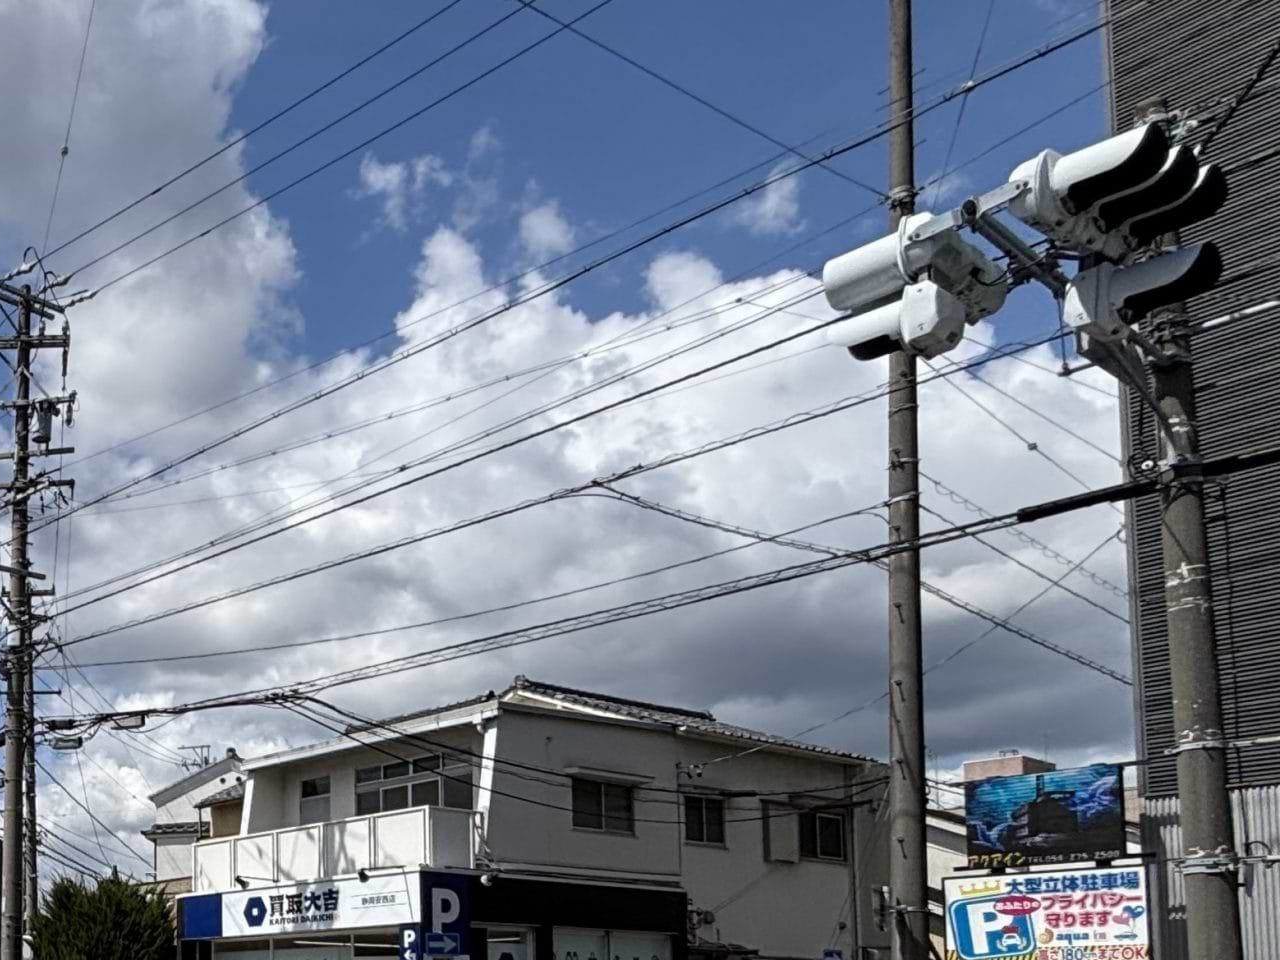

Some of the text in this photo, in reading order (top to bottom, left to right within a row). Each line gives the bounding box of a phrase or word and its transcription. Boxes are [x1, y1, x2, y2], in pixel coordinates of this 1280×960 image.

[968, 853, 1026, 868] アクアイン
[1005, 871, 1140, 895] 大型立体駐車場
[269, 888, 339, 917] 買取大吉
[431, 887, 460, 934] P
[1041, 893, 1143, 911] プライバシー
[269, 913, 333, 926] KAITORI DAIKICHI
[1044, 911, 1113, 928] 守ります
[966, 903, 1015, 955] P
[403, 929, 416, 948] P
[1056, 932, 1090, 945] aqua
